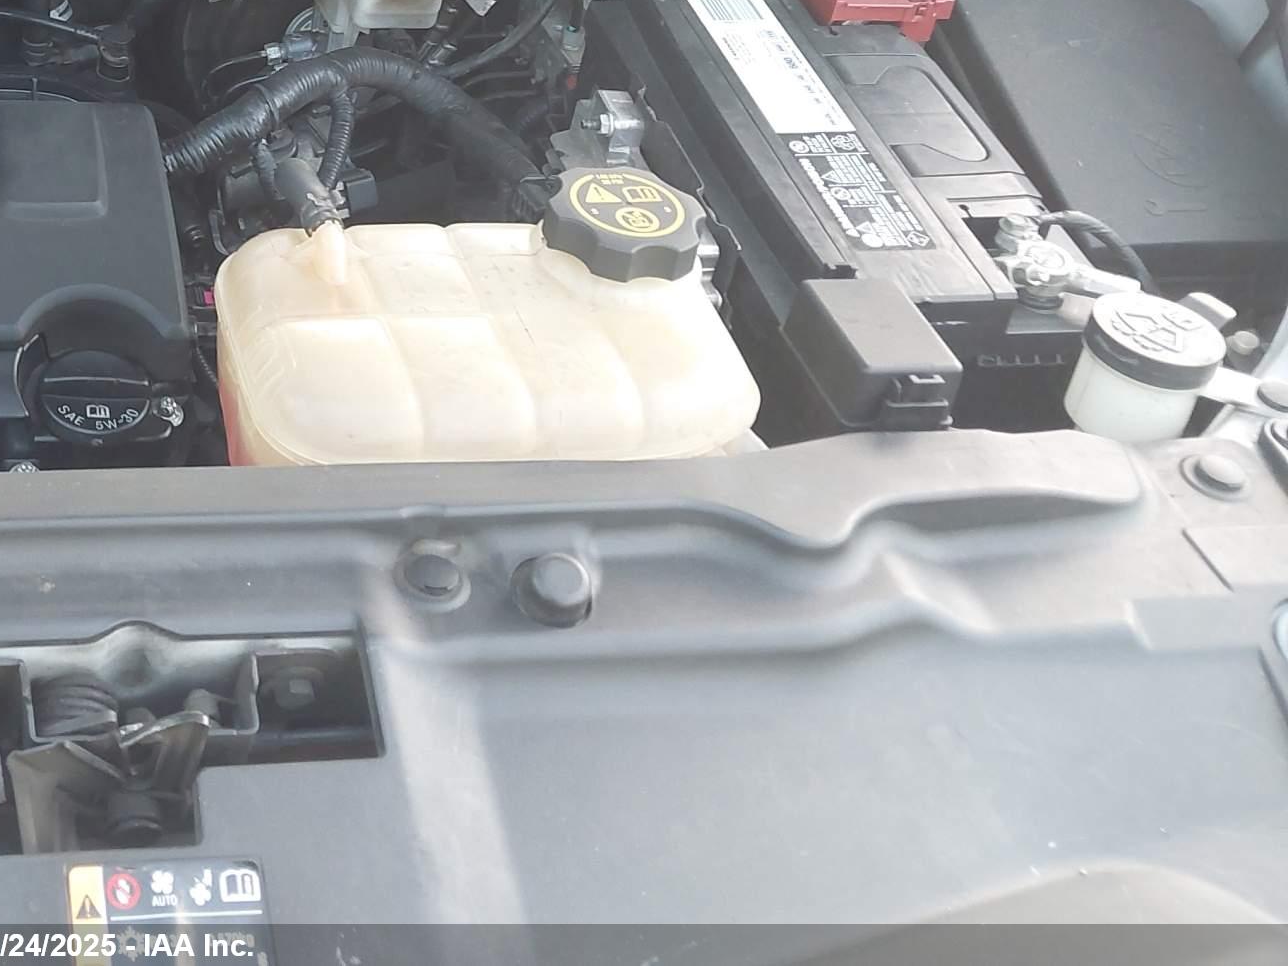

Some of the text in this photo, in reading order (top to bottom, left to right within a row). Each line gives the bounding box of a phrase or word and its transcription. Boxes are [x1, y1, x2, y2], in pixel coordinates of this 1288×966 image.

[58, 405, 138, 430] SAE 5W-30
[151, 894, 178, 907] AUTO
